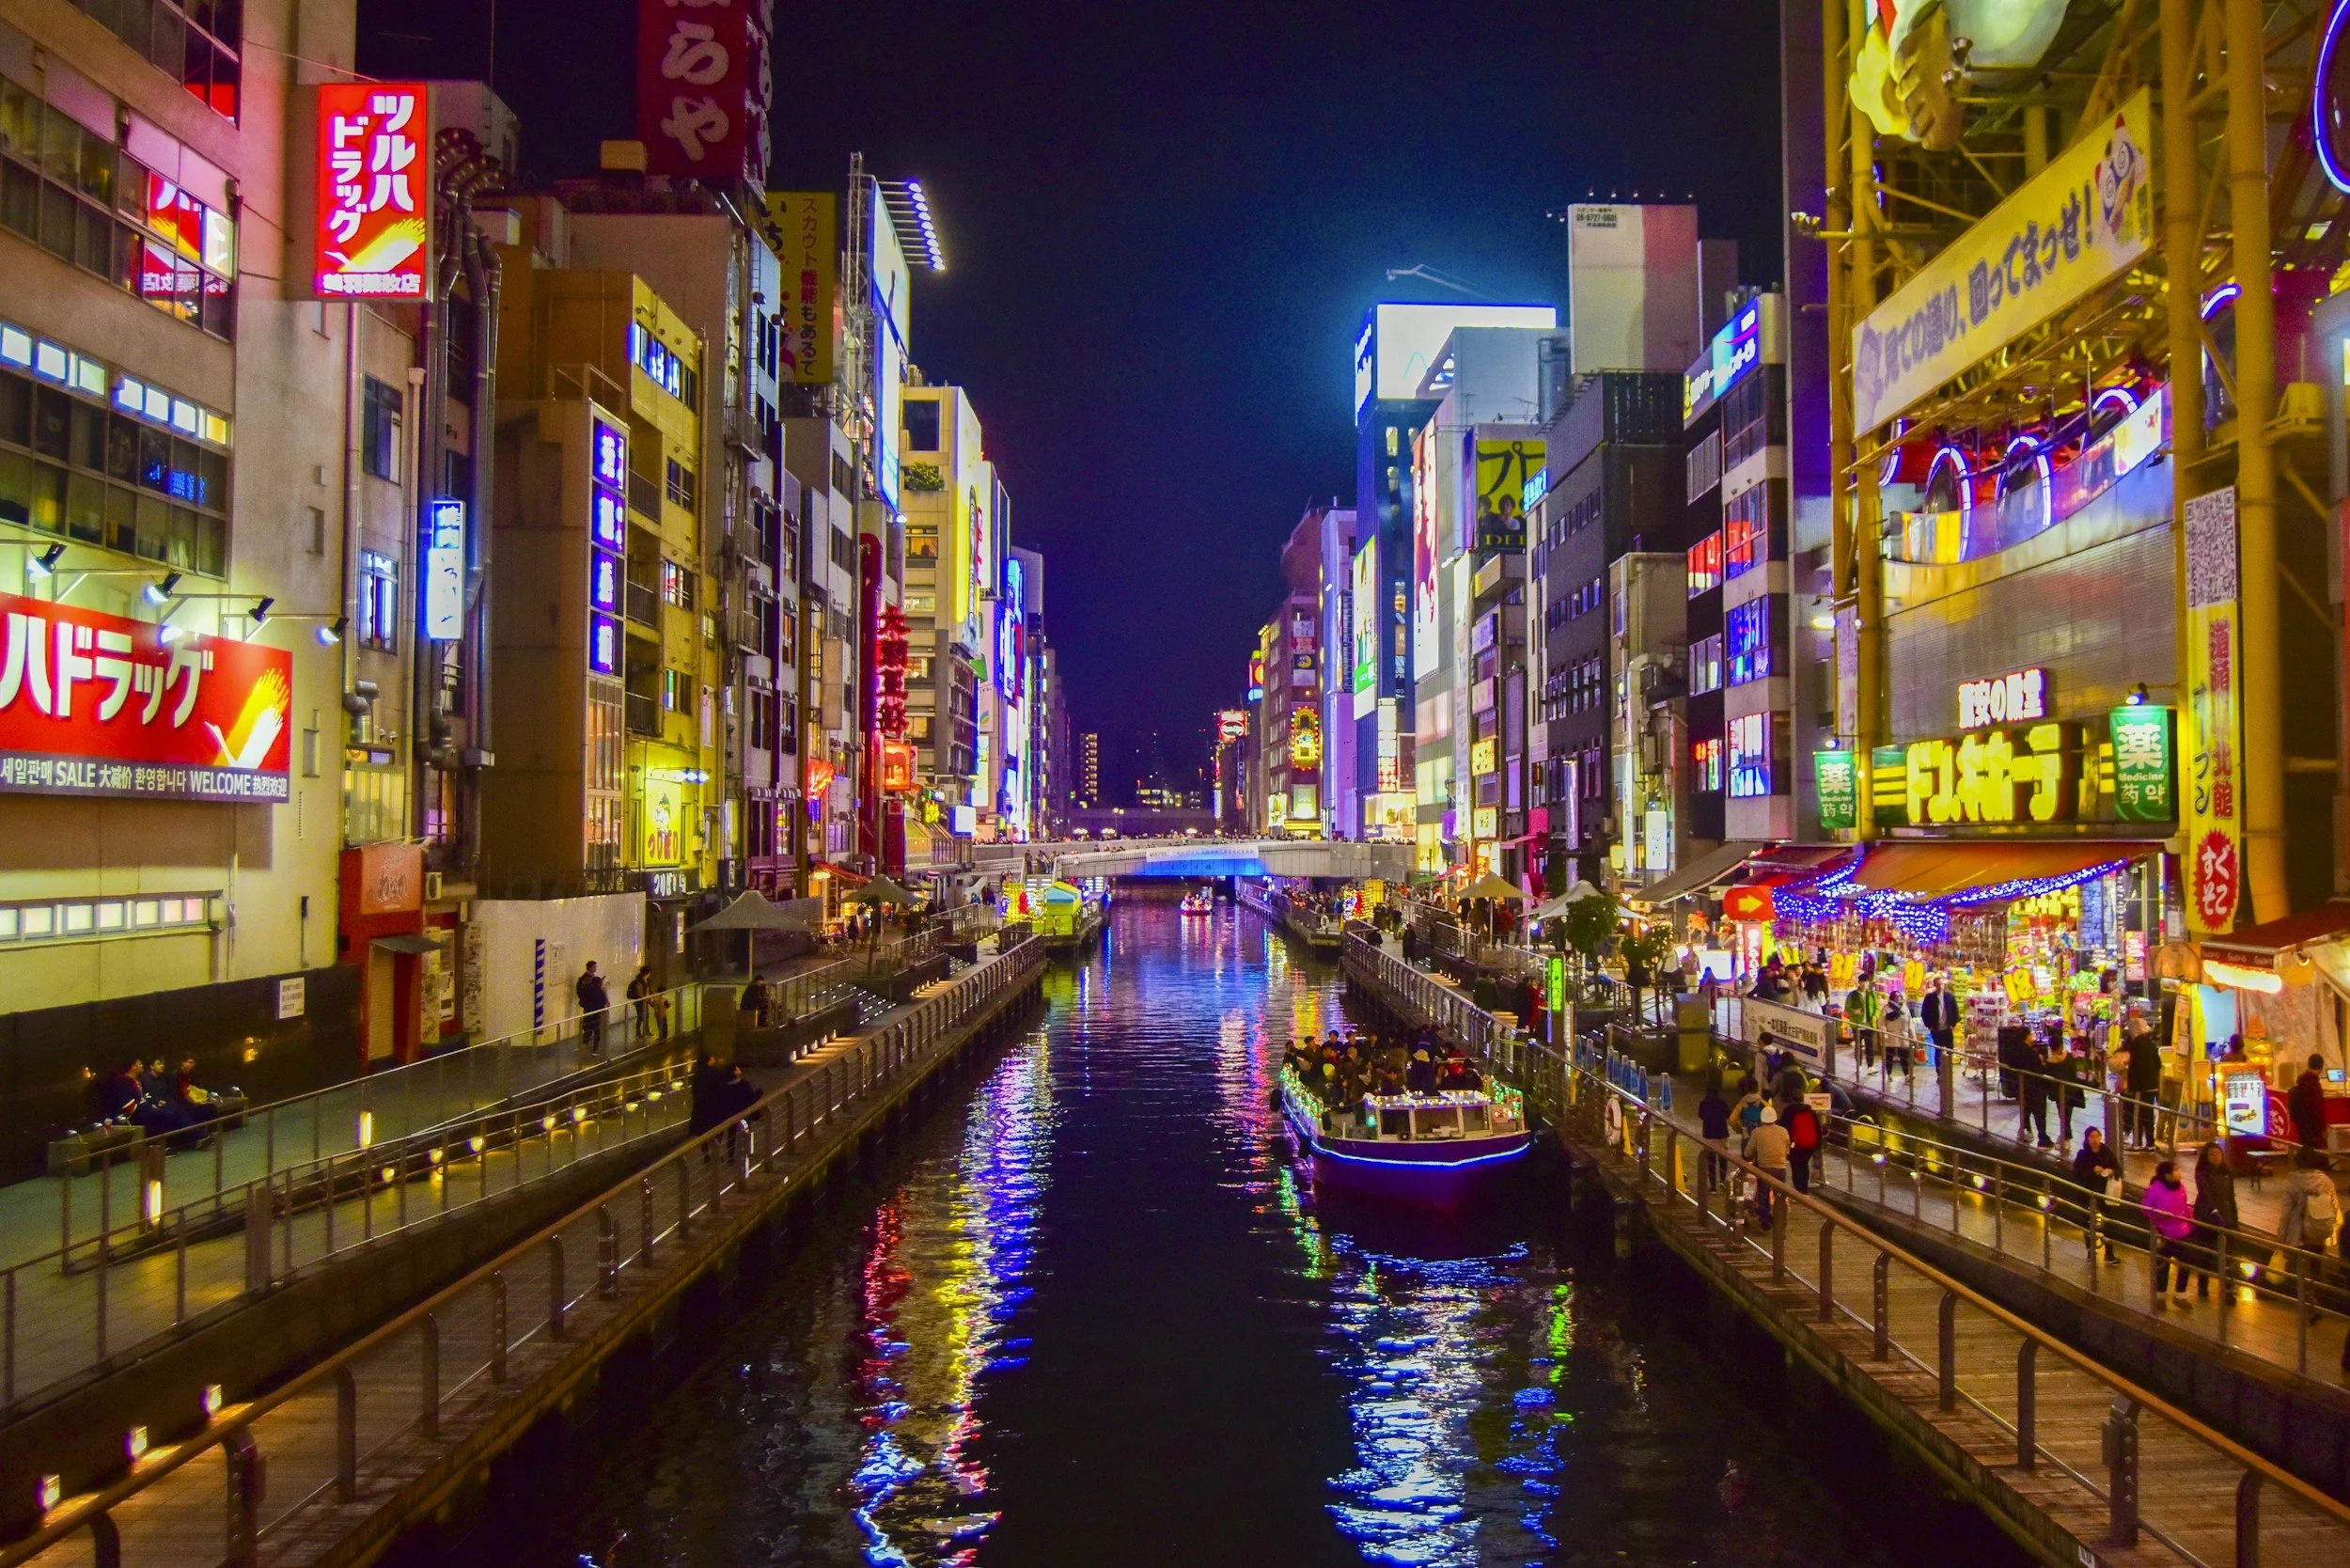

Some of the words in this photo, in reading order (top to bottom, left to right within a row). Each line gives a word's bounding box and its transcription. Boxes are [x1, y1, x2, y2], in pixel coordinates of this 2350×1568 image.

[660, 0, 730, 162] らや
[370, 95, 416, 212] ツルハ
[330, 116, 368, 243] ドラッグ
[0, 613, 214, 729] ハドラッグ
[2117, 723, 2164, 769] 薬
[0, 758, 53, 786] 세일판매
[55, 760, 97, 788] SALE
[134, 766, 187, 793] 환영합니다
[190, 770, 251, 795] WELCOME
[1820, 762, 1853, 793] 薬
[2118, 773, 2165, 781] Medicine
[2201, 844, 2231, 882] すぐ
[2202, 883, 2229, 916] そこ
